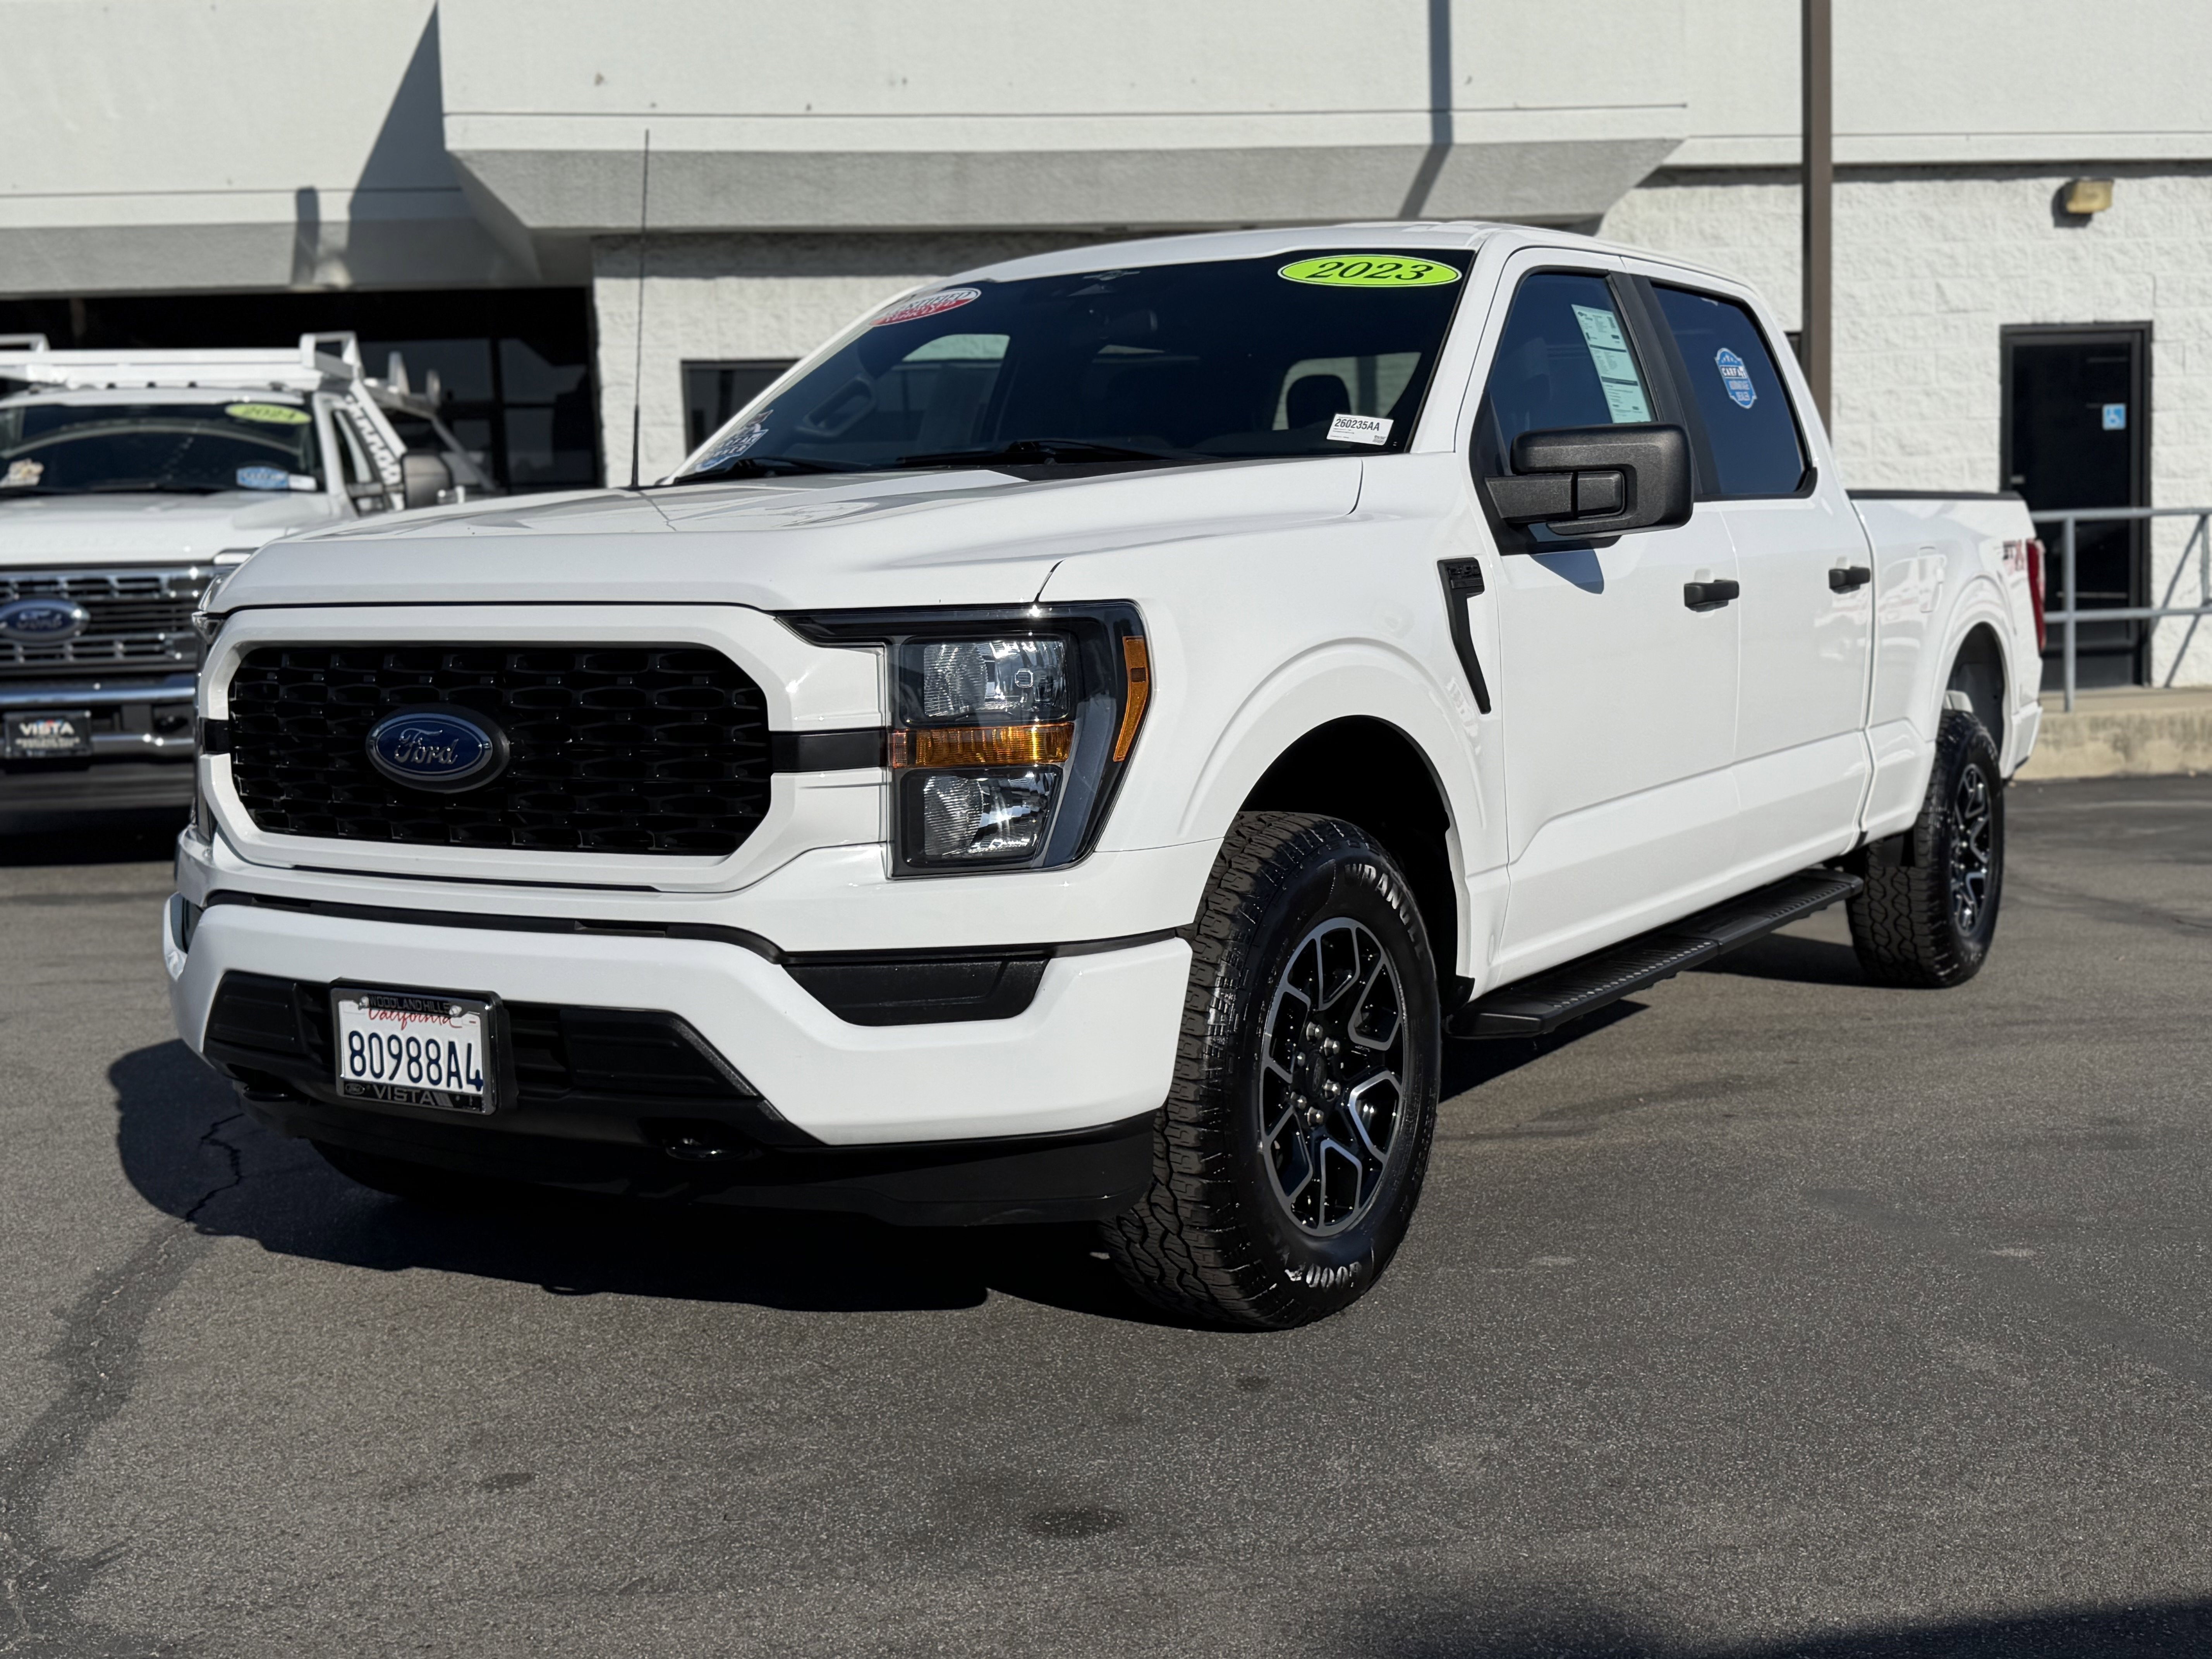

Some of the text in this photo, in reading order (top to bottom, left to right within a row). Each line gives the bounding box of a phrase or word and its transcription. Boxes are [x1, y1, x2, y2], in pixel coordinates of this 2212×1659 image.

[1305, 261, 1434, 280] 2023
[1334, 418, 1380, 431] 260235AA
[394, 728, 459, 764] Ford
[369, 995, 450, 1014] WOODLAND HILLS
[349, 1030, 484, 1092] 80988A4
[373, 1084, 436, 1106] VISTA
